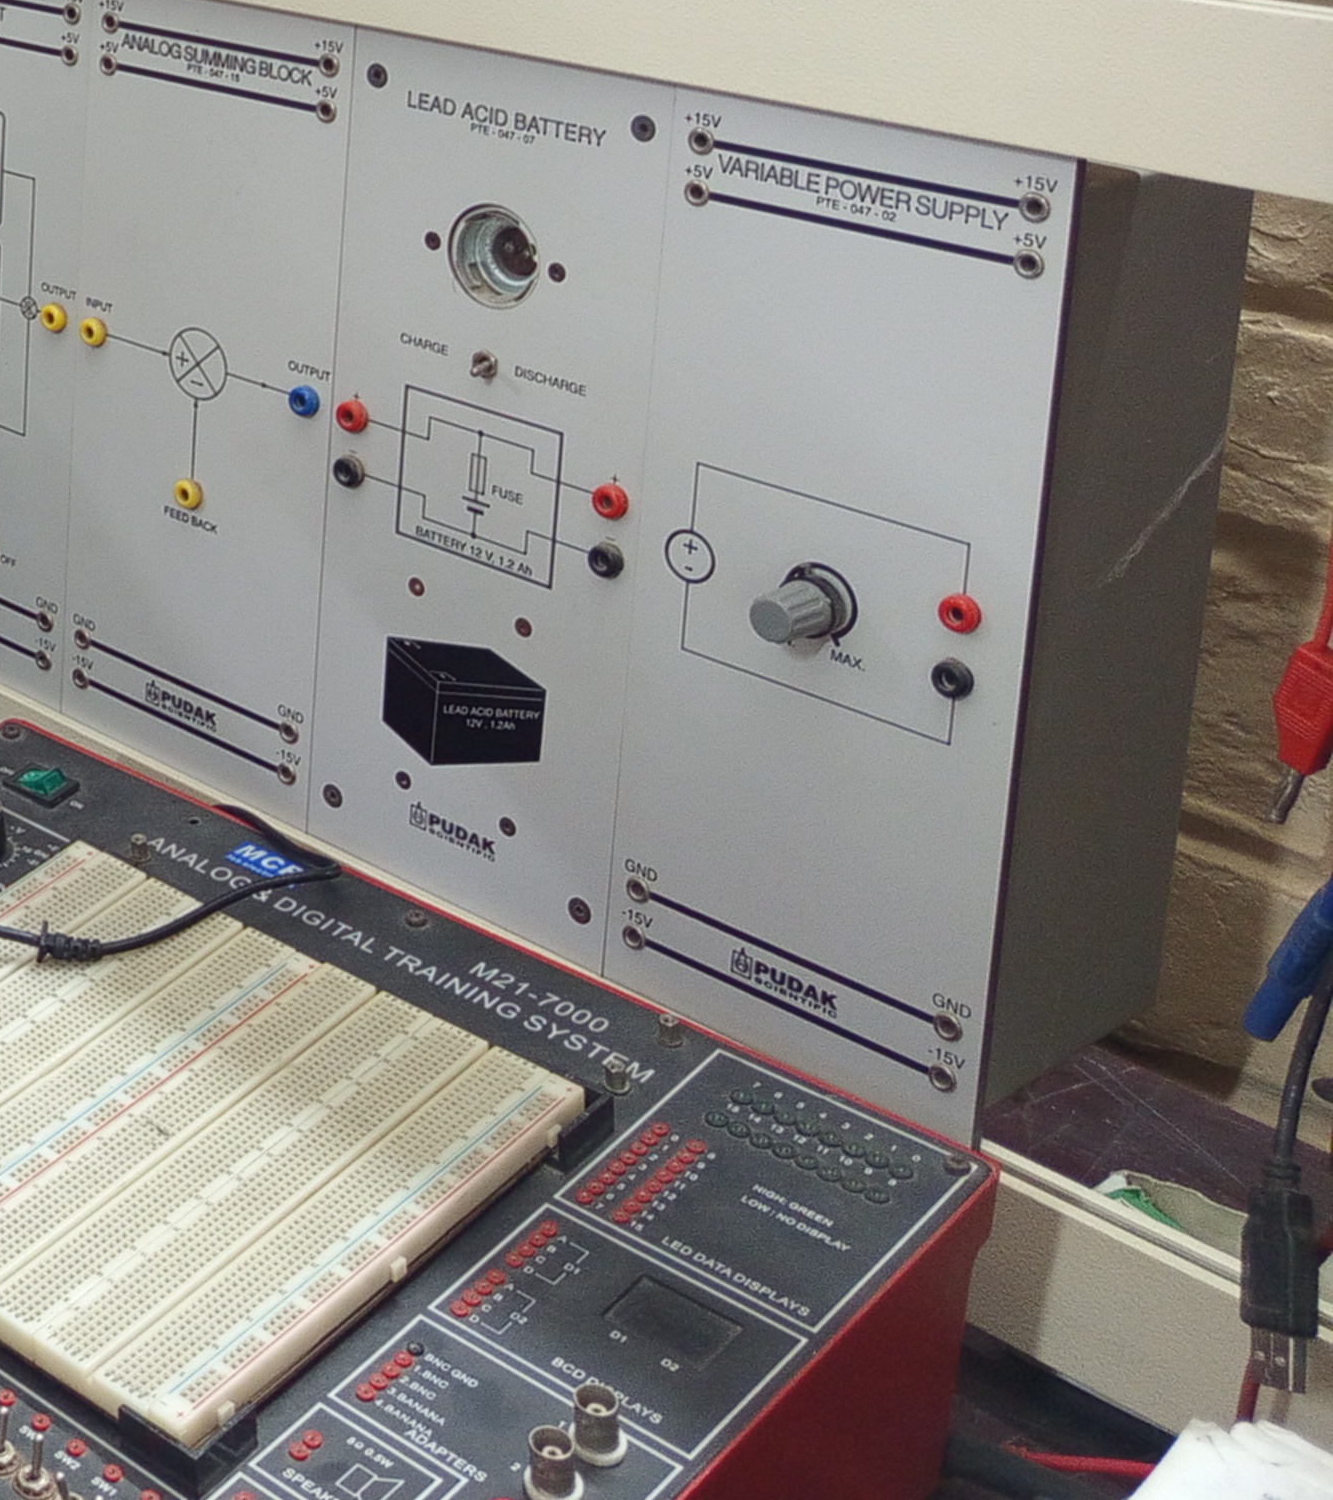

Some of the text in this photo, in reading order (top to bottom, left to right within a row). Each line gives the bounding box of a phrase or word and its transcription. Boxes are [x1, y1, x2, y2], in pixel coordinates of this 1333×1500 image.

[98, 0, 124, 12] +15V
[60, 32, 80, 45] +5V
[99, 41, 120, 54] +5V
[314, 40, 343, 54] +15V
[121, 32, 313, 88] ANALOG SUMMING BLOCK
[315, 85, 338, 99] +5V
[406, 90, 607, 148] LEAD ACID BATTERY
[684, 112, 722, 129] +15V
[684, 164, 713, 180] +5V
[718, 153, 1009, 232] VARIABLE POWER SUPPLY
[1013, 176, 1058, 194] +15V
[816, 195, 897, 223] PTE 047 02
[1012, 233, 1047, 250] +5V
[40, 281, 77, 301] OUTPUT
[85, 296, 113, 314] INPUT
[399, 332, 449, 356] CHARGE
[287, 359, 332, 383] OUTPUT
[514, 365, 587, 397] DISCHARGE
[491, 485, 524, 505] FUSE
[163, 505, 218, 535] FEED BACK
[35, 596, 59, 615] GND
[72, 613, 96, 632] GND
[830, 649, 866, 673] MAX.
[160, 687, 217, 727] PUDAK
[277, 704, 305, 725] GND
[443, 704, 540, 721] LEAD ACID BATTERY
[275, 749, 302, 768] -15V
[428, 813, 496, 855] PUDAK
[624, 858, 658, 883] GND
[621, 909, 653, 929] -15V
[147, 834, 254, 890] ANALOG
[273, 895, 377, 954] DIGITAL
[383, 944, 521, 1021] TRAINING
[522, 1013, 656, 1085] SYSTEM
[754, 960, 838, 1012] PUDAK
[469, 960, 610, 1036] M21-7000
[754, 976, 838, 1020] SCIENTIFIC
[932, 993, 973, 1020] GND
[927, 1048, 967, 1071] -15V
[740, 1194, 851, 1253] LOW NO DISPLAY
[563, 1261, 581, 1275] D1
[661, 1235, 810, 1318] LED DATA DISPLAYS
[509, 1310, 529, 1326] D2
[609, 1330, 628, 1344] D1
[423, 1352, 479, 1389] BNC GND
[660, 1357, 681, 1373] D2
[386, 1387, 446, 1427] 3.BANANA
[54, 1450, 81, 1471] SW2
[404, 1428, 488, 1483] ADAPTERS
[91, 1476, 118, 1497] SW1
